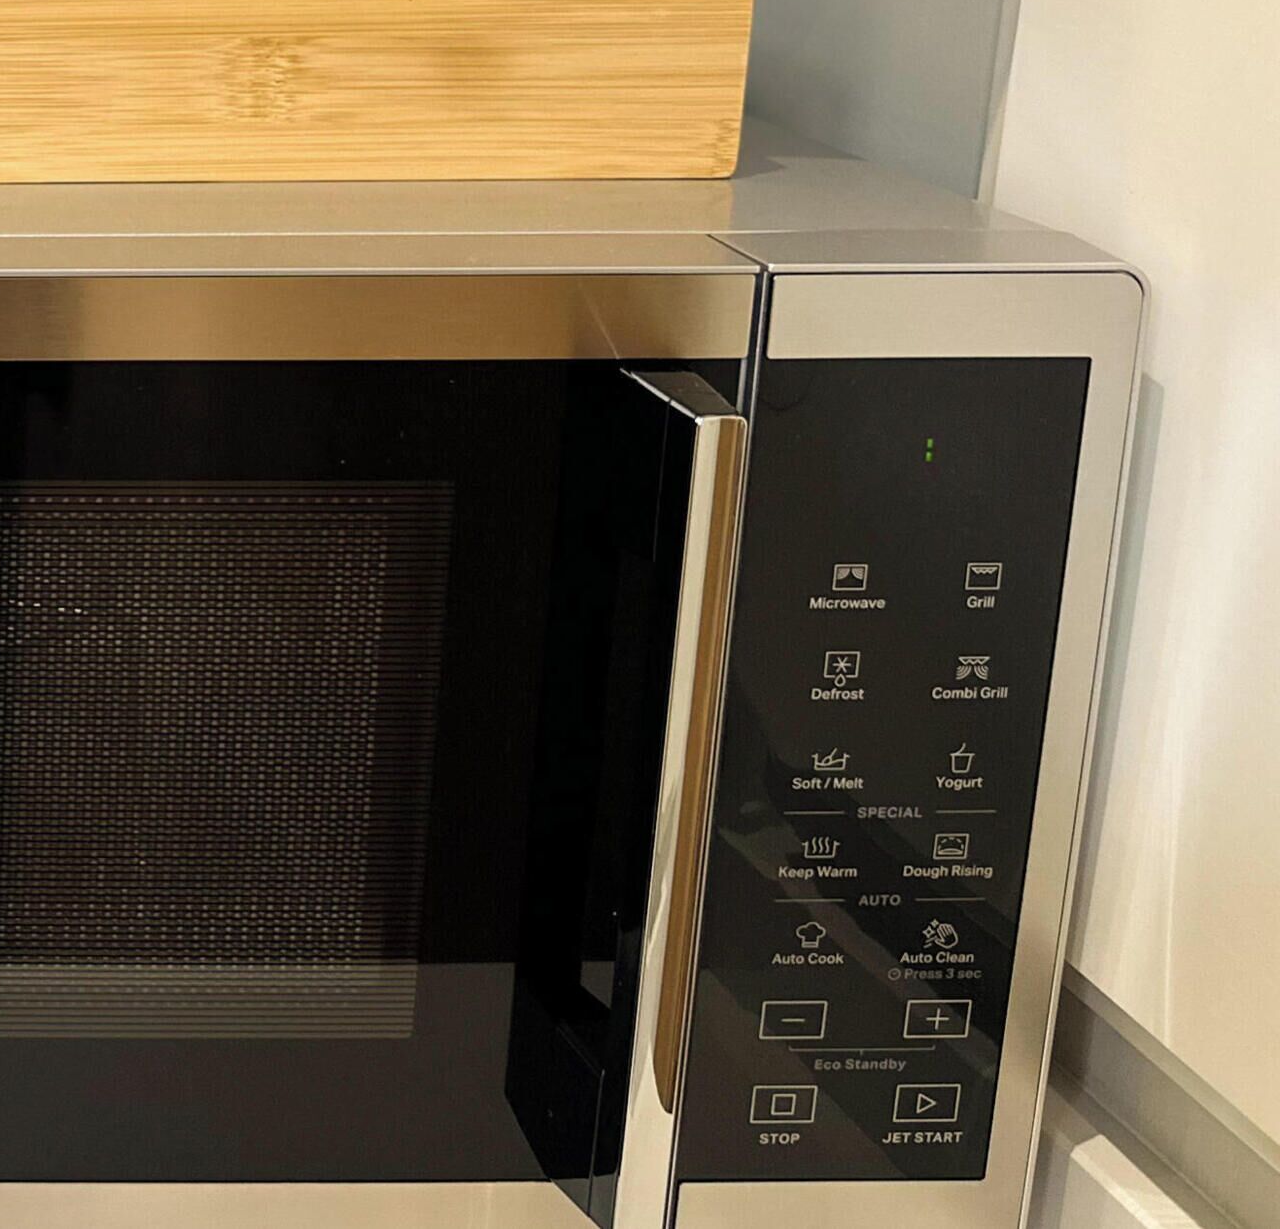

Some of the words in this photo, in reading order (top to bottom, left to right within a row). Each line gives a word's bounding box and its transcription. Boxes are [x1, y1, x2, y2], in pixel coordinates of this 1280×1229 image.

[809, 596, 886, 610] Microwave
[966, 595, 996, 609] Grill
[810, 687, 865, 701] Defrost
[931, 686, 978, 700] Combi
[980, 686, 1009, 699] Grill
[791, 777, 822, 790] Soft
[834, 777, 864, 789] Melt
[935, 776, 984, 791] Yogurt
[857, 806, 923, 819] SPECIAL
[778, 866, 815, 881] Keep
[817, 865, 858, 878] Warm
[902, 865, 949, 880] Dough
[951, 864, 994, 879] Rising
[858, 894, 902, 907] AUTO
[771, 953, 805, 965] Auto
[807, 952, 844, 965] Cook
[899, 952, 932, 964] Auto
[935, 951, 975, 964] Clean
[903, 968, 943, 981] Press
[957, 970, 982, 979] sec
[813, 1058, 842, 1071] Eco
[844, 1058, 907, 1073] Standby
[759, 1132, 801, 1145] STOP
[881, 1131, 912, 1144] JET
[914, 1131, 964, 1144] START
